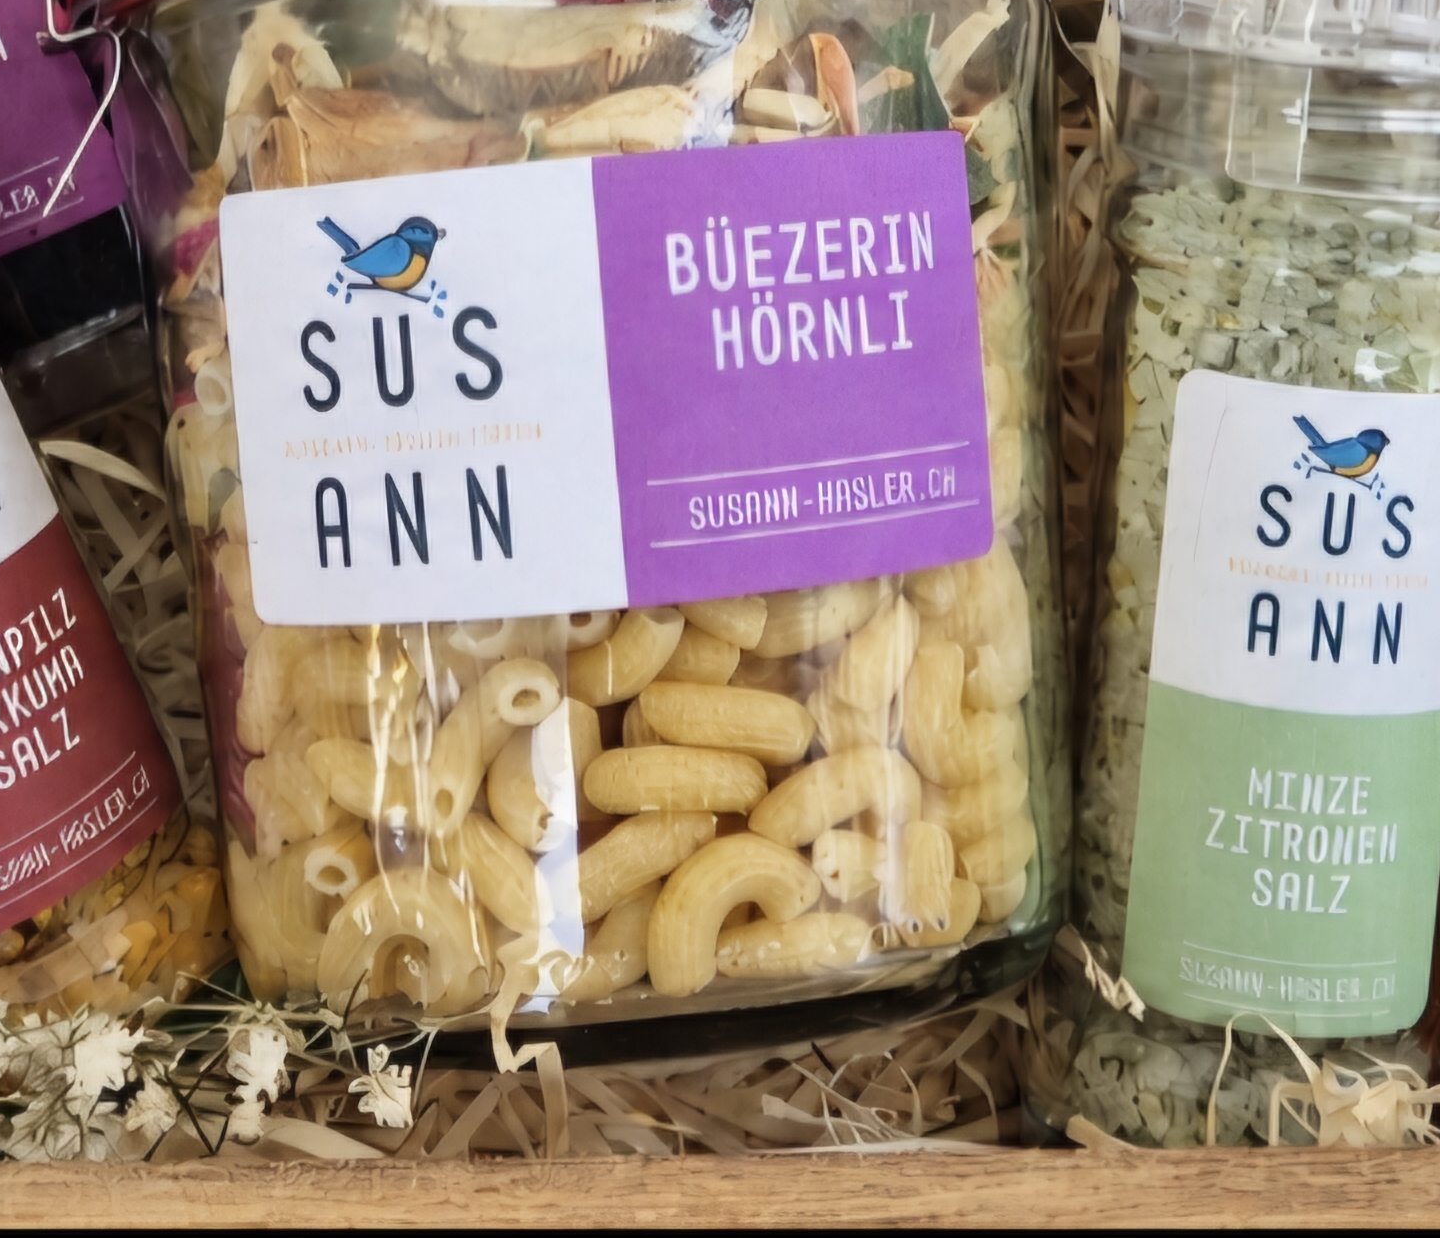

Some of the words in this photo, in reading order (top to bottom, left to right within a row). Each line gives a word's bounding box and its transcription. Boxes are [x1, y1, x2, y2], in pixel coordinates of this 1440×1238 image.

[666, 212, 935, 296] BÜEZERIN
[301, 306, 504, 413] SUS
[711, 290, 913, 371] HÖRNLI
[314, 465, 514, 568] ANN
[689, 466, 955, 530] SUSANN-HASLER.CH
[1256, 484, 1415, 559] SUS
[1247, 593, 1403, 665] ANN
[1248, 767, 1371, 815] MINZE
[1205, 807, 1397, 865] ZITRONEN
[1251, 868, 1350, 913] SALZ
